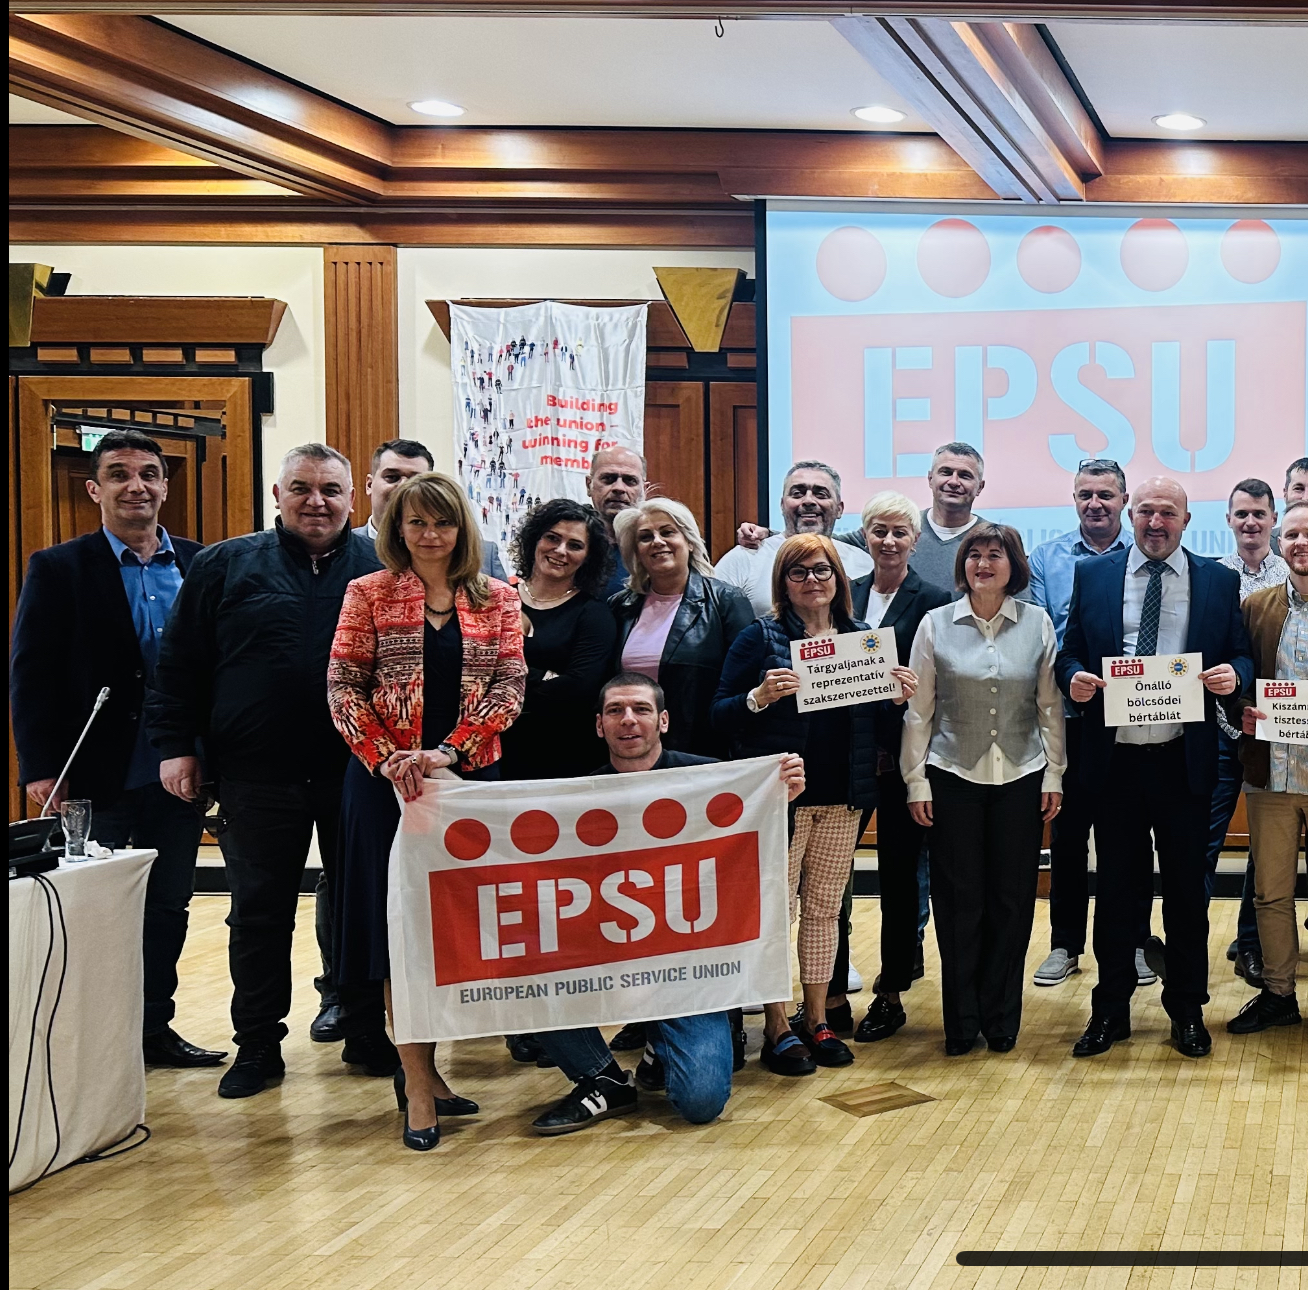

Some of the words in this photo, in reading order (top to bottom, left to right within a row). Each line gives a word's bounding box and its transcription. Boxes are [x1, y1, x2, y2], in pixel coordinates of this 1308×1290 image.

[546, 394, 618, 415] Building
[864, 340, 1236, 478] EPSU
[526, 415, 551, 429] the
[556, 416, 607, 432] union
[522, 433, 589, 453] winning
[540, 455, 592, 470] memb
[804, 645, 832, 659] EPSU
[807, 656, 876, 675] Tárgyaljanak
[878, 656, 886, 664] a
[1114, 665, 1140, 676] EPSU
[811, 670, 885, 689] reprezentatív
[1135, 680, 1172, 692] Önálló
[803, 683, 896, 706] szakszervezettel!
[1127, 695, 1182, 707] bölcsődei
[1267, 687, 1293, 697] EPSU
[1129, 711, 1182, 723] bértáblát
[477, 857, 718, 960] EPSU
[460, 983, 548, 1004] EUROPEAN
[555, 975, 614, 996] PUBLIC
[620, 966, 687, 988] SERVICE
[693, 960, 741, 979] UNION
